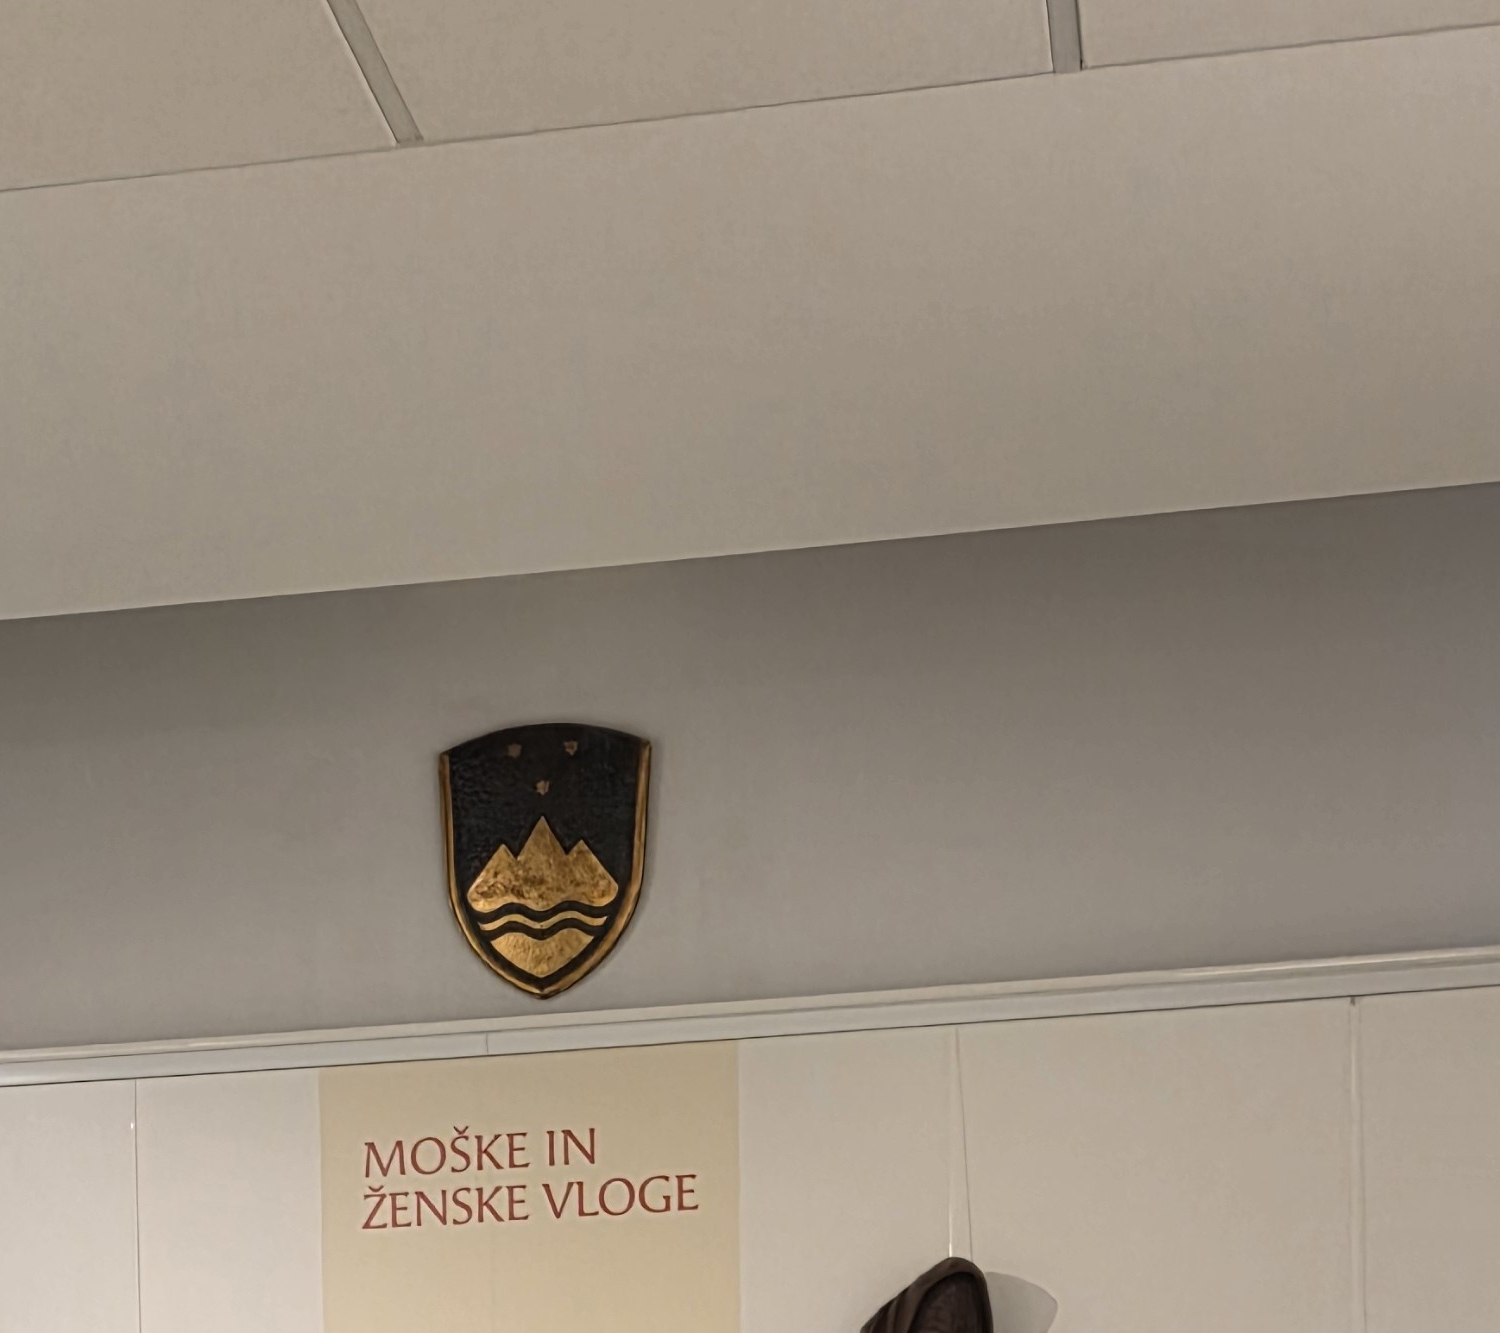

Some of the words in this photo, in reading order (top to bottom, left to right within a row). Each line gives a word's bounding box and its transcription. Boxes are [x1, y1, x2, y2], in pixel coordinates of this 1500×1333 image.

[364, 1126, 532, 1179] MOŠKE
[546, 1128, 596, 1167] IN
[362, 1184, 531, 1230] ŽENSKE
[542, 1174, 700, 1220] VLOGE
